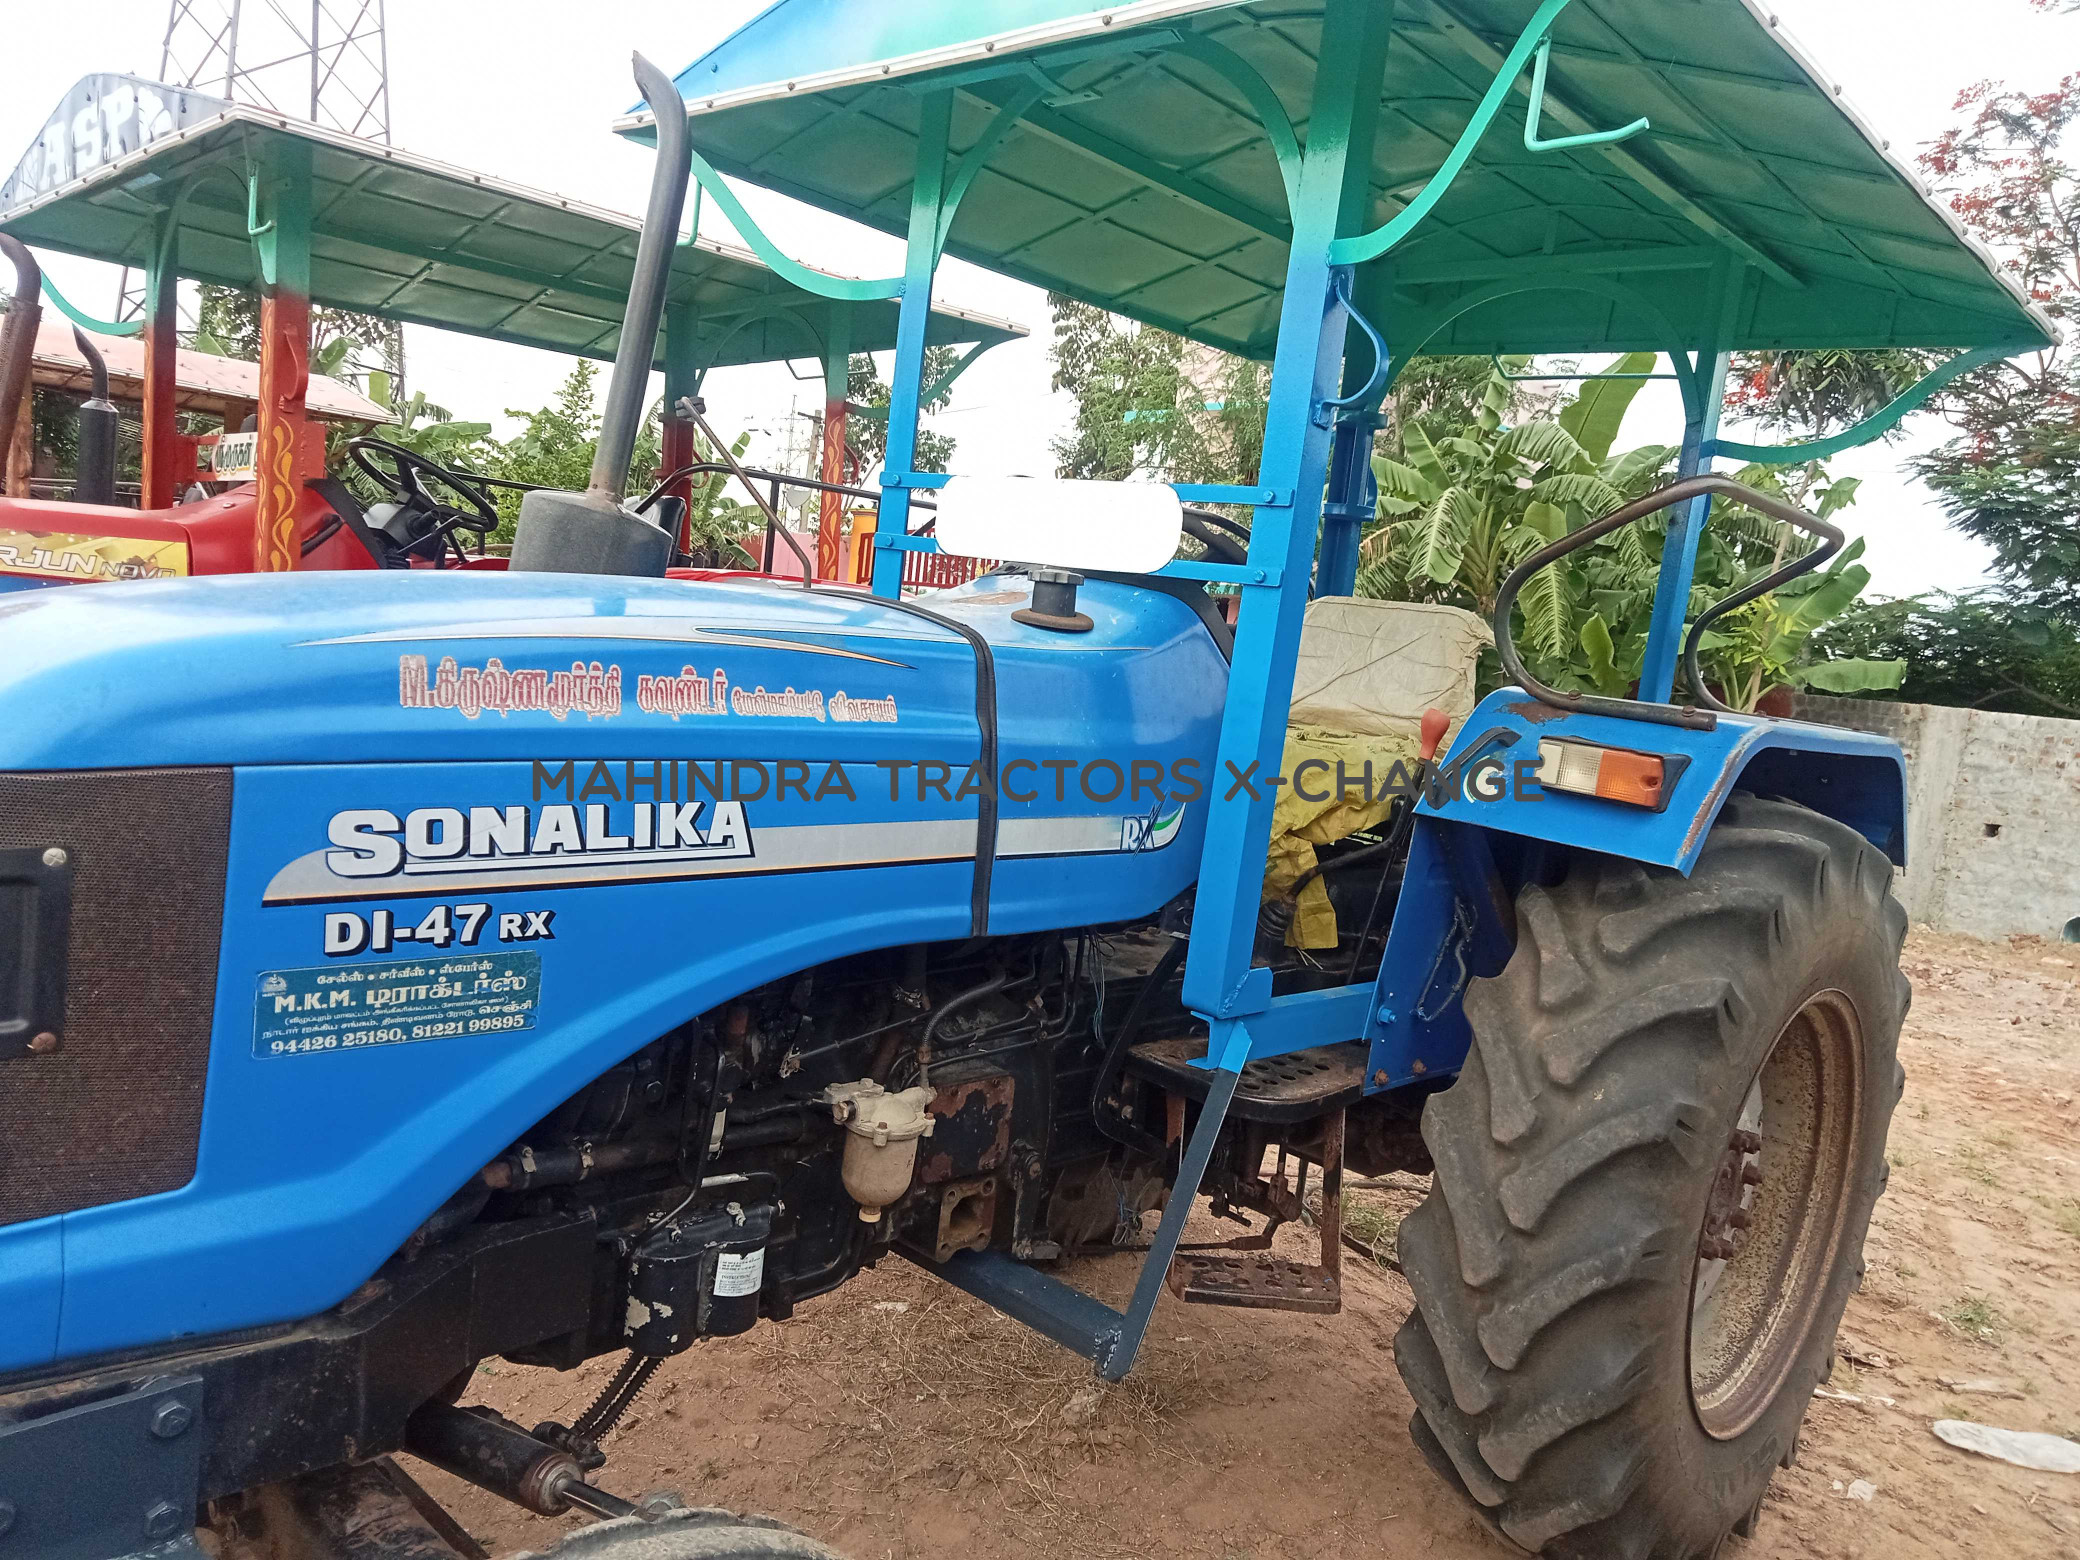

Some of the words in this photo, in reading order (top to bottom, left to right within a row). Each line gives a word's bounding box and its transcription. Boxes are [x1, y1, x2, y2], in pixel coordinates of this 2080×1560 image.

[325, 801, 754, 877] SONALIKA
[1121, 805, 1161, 853] RX
[323, 904, 493, 957] DI-47
[499, 910, 556, 942] RX
[274, 988, 357, 1013] M.K.M.
[270, 1036, 338, 1055] 94426
[342, 1028, 407, 1047] 25180,
[412, 1022, 467, 1039] 81221
[468, 1015, 525, 1032] 99895
